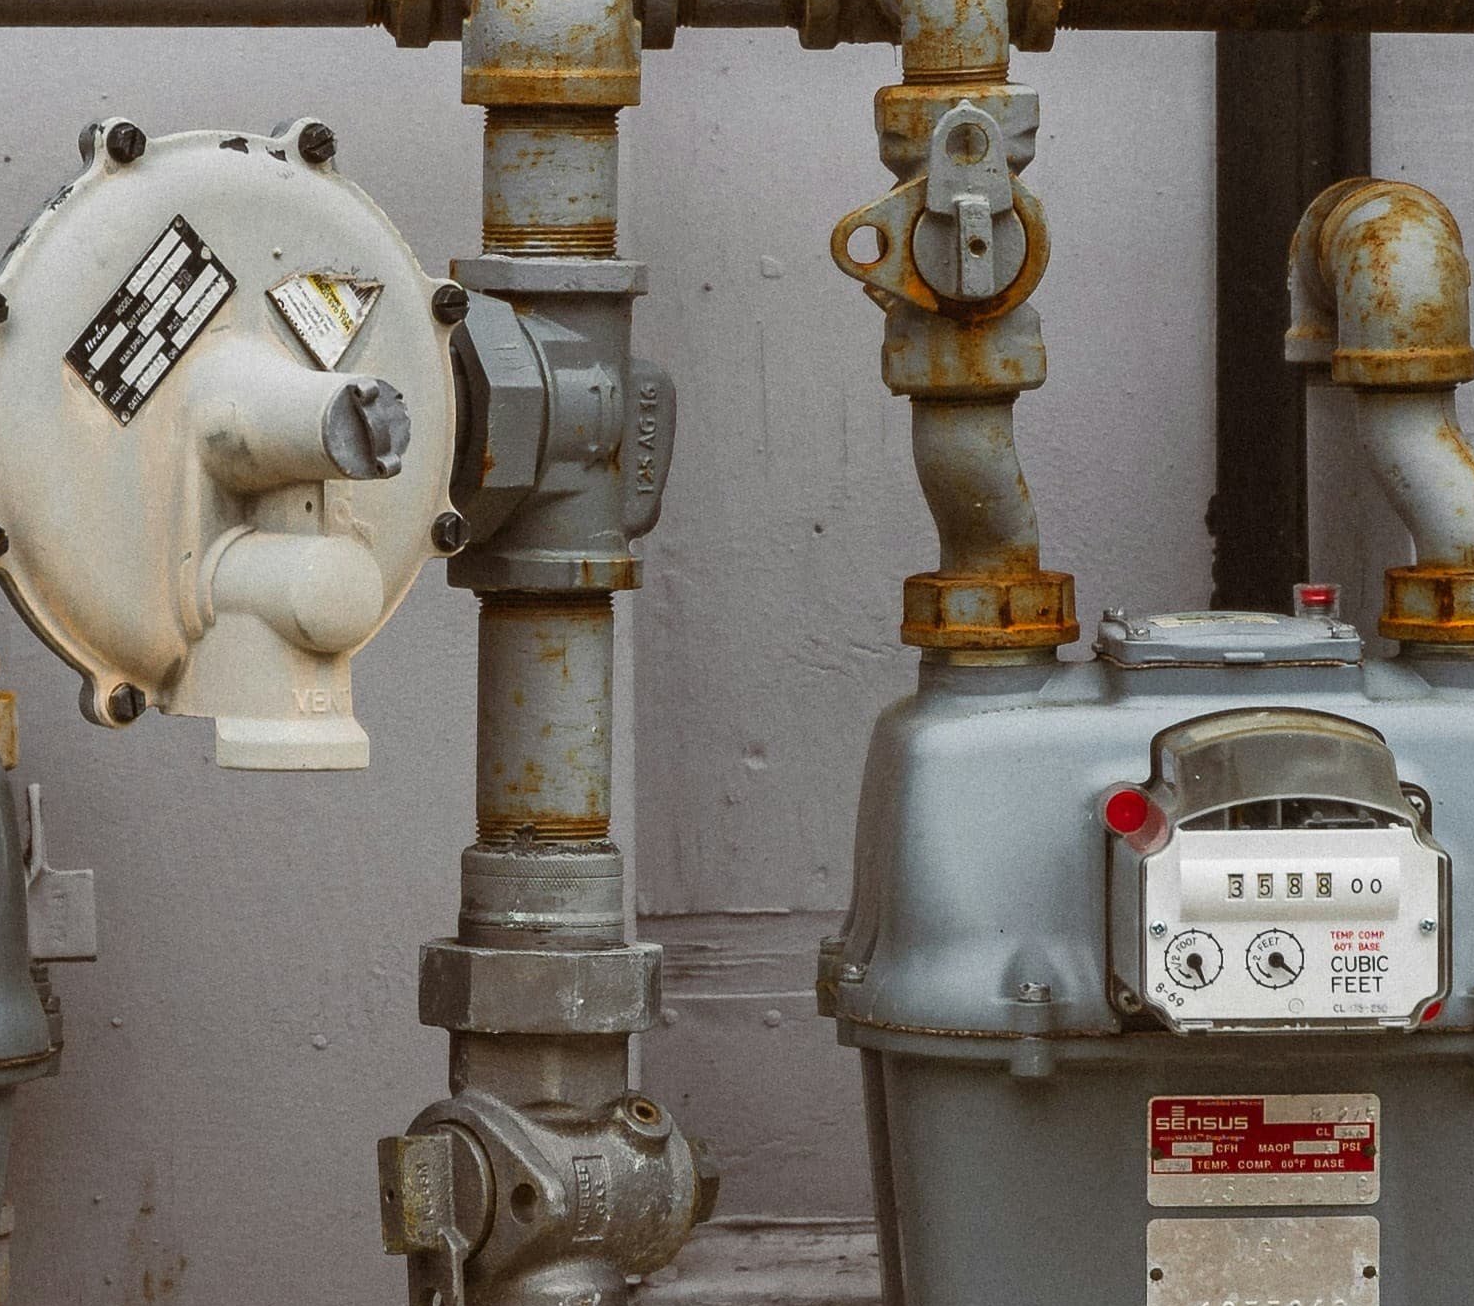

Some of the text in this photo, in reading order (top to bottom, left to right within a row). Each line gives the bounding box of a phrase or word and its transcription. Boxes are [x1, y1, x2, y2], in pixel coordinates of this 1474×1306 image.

[1230, 877, 1332, 898] 3588
[1175, 936, 1198, 953] FOOT
[1256, 936, 1280, 951] FEET
[1358, 942, 1380, 951] BASE
[1330, 955, 1389, 973] CUBIC
[1331, 976, 1384, 993] FEET
[1155, 982, 1185, 1008] 8-69
[1315, 1127, 1332, 1136] CL
[1215, 1143, 1239, 1153] CFH
[1258, 1143, 1291, 1153] MAOP
[1342, 1141, 1361, 1151] PSI
[1196, 1160, 1230, 1169] TEMP.
[1237, 1160, 1273, 1169] COMP.
[1313, 1159, 1345, 1168] BASE
